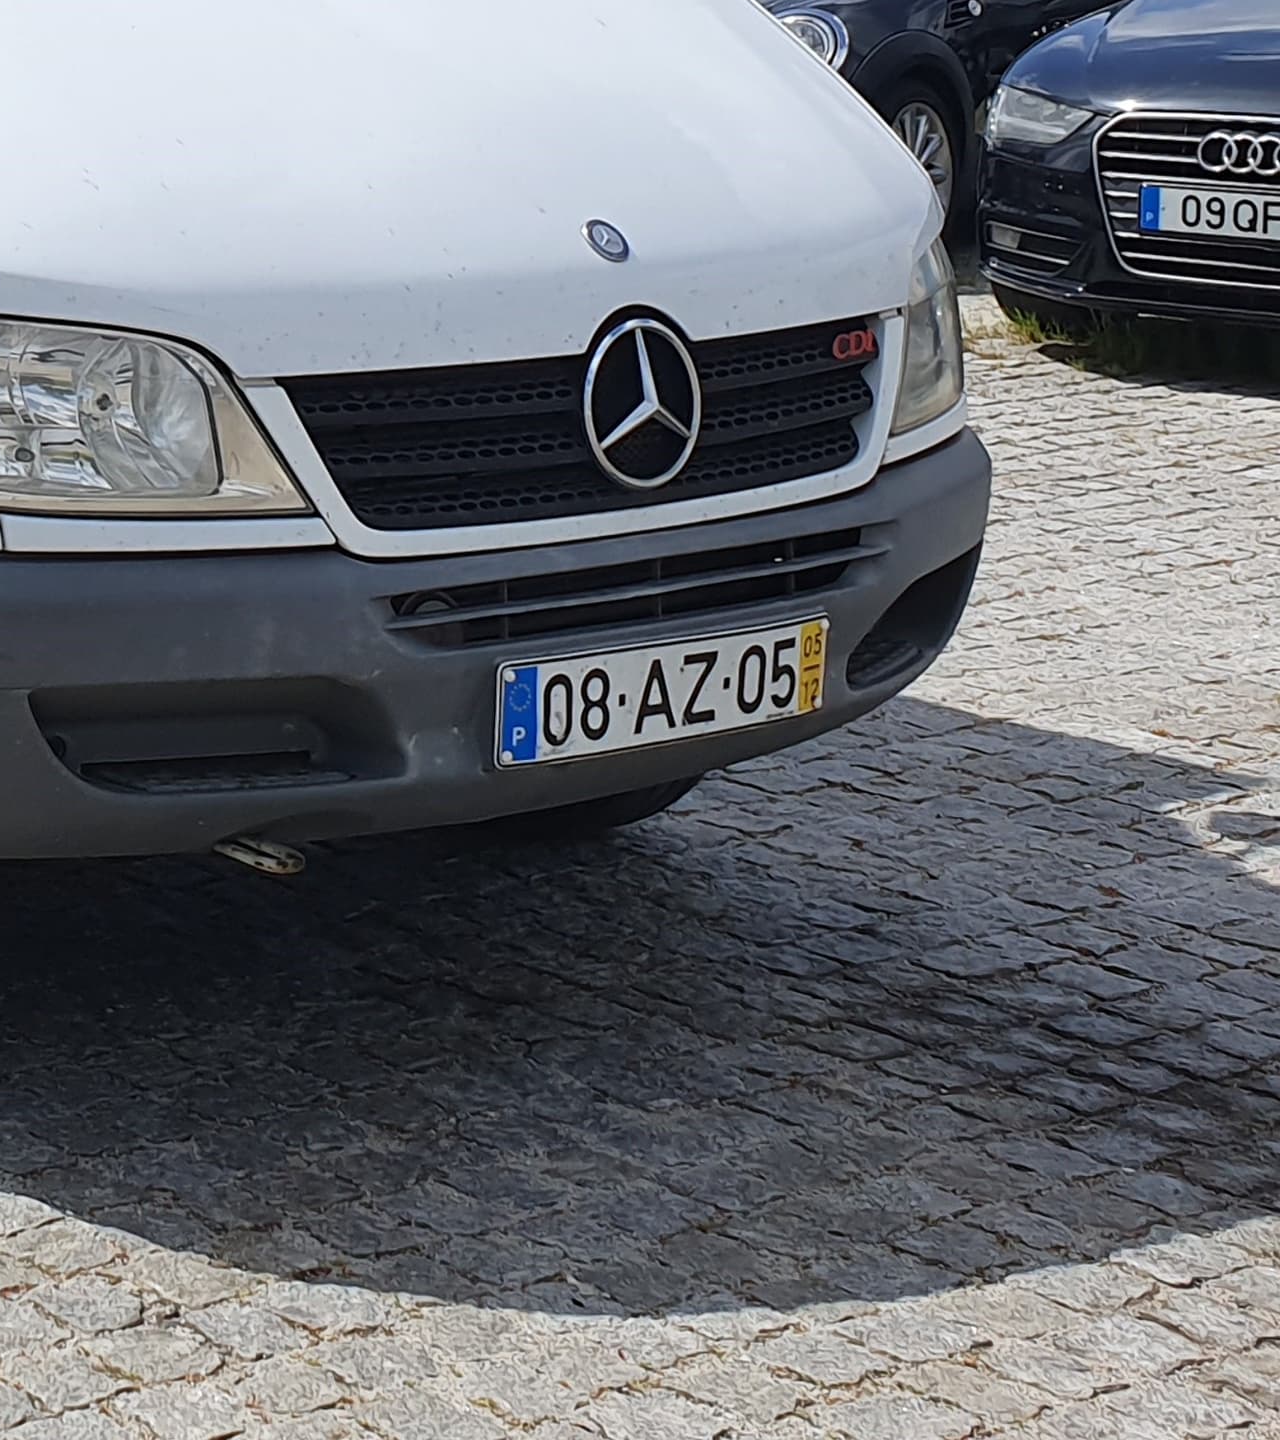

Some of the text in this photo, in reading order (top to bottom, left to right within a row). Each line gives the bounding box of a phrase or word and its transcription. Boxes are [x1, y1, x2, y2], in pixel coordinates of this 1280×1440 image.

[832, 329, 876, 359] CDI
[804, 633, 822, 658] 05
[511, 726, 526, 747] P
